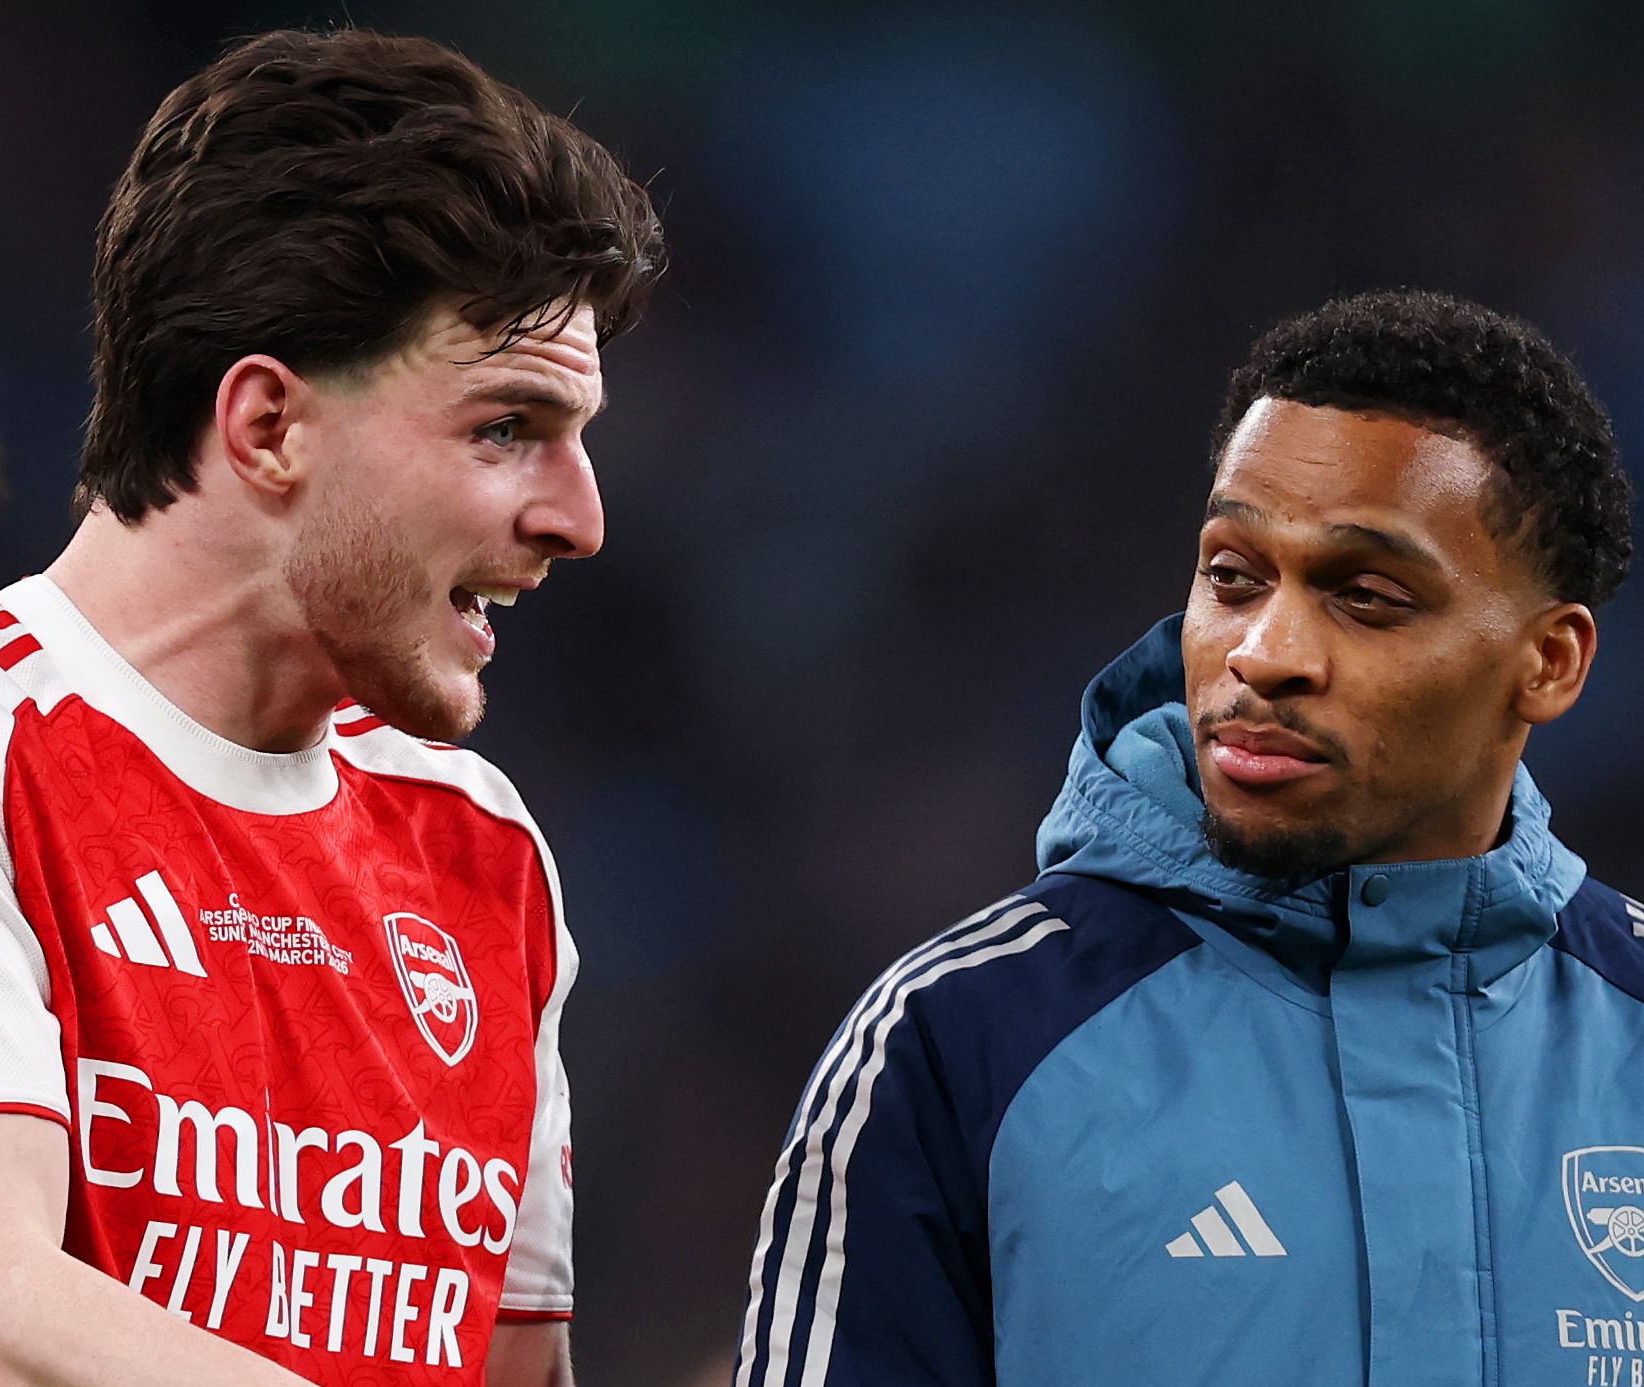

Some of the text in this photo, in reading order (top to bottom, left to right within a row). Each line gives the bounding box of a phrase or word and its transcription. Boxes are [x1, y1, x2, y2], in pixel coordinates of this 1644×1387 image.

[261, 915, 293, 932] CUP
[267, 947, 326, 966] MARCH
[399, 934, 456, 973] Arsenal
[76, 1057, 520, 1256] Emirates
[127, 1220, 471, 1369] FLY BETTER
[1587, 1355, 1623, 1387] FLY
